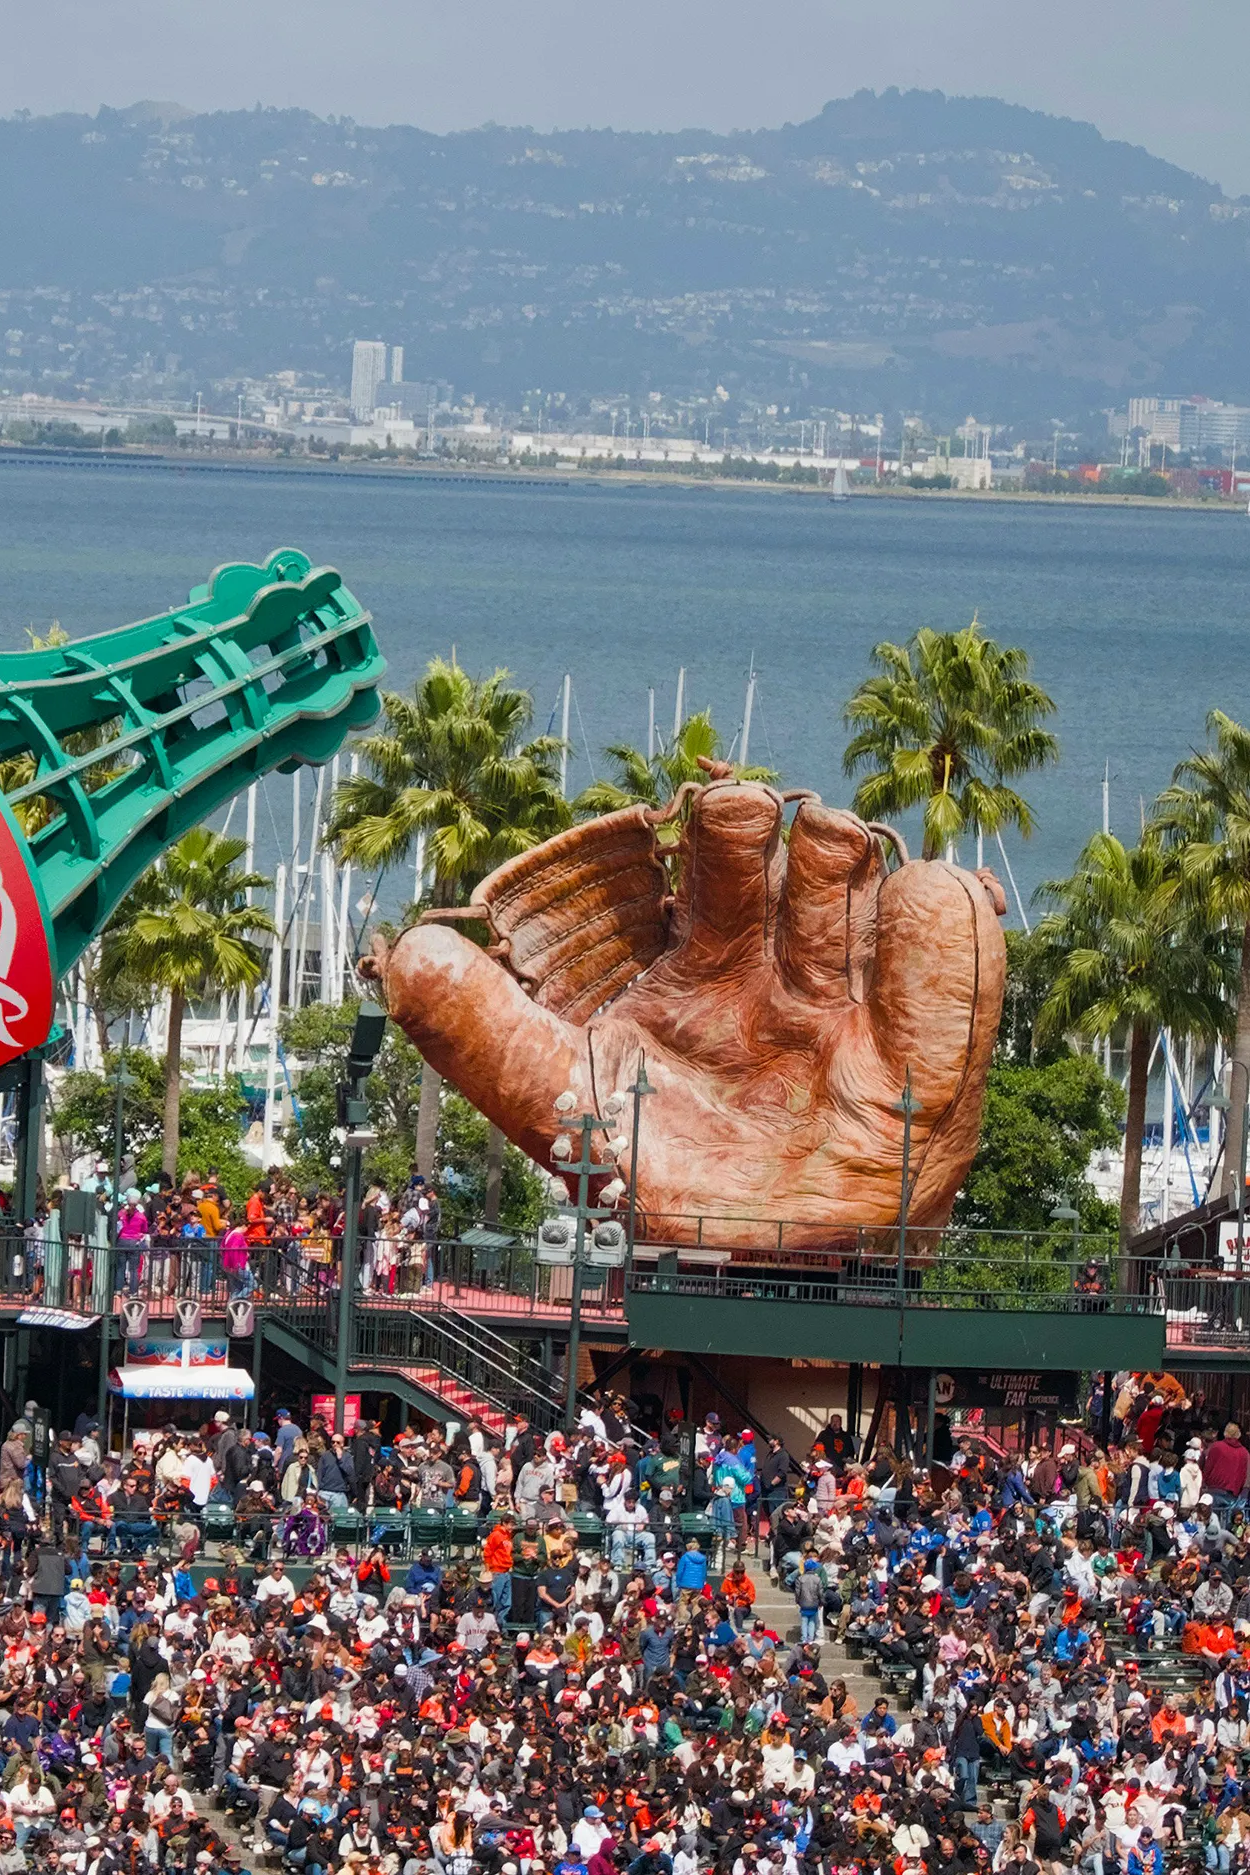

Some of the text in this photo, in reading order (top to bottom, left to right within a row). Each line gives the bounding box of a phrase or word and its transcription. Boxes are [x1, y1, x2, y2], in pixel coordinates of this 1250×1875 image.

[991, 1375, 1042, 1390] ULTIMATE
[149, 1386, 183, 1398] TASTE
[203, 1386, 229, 1398] FUN!
[1004, 1391, 1027, 1406] FAN
